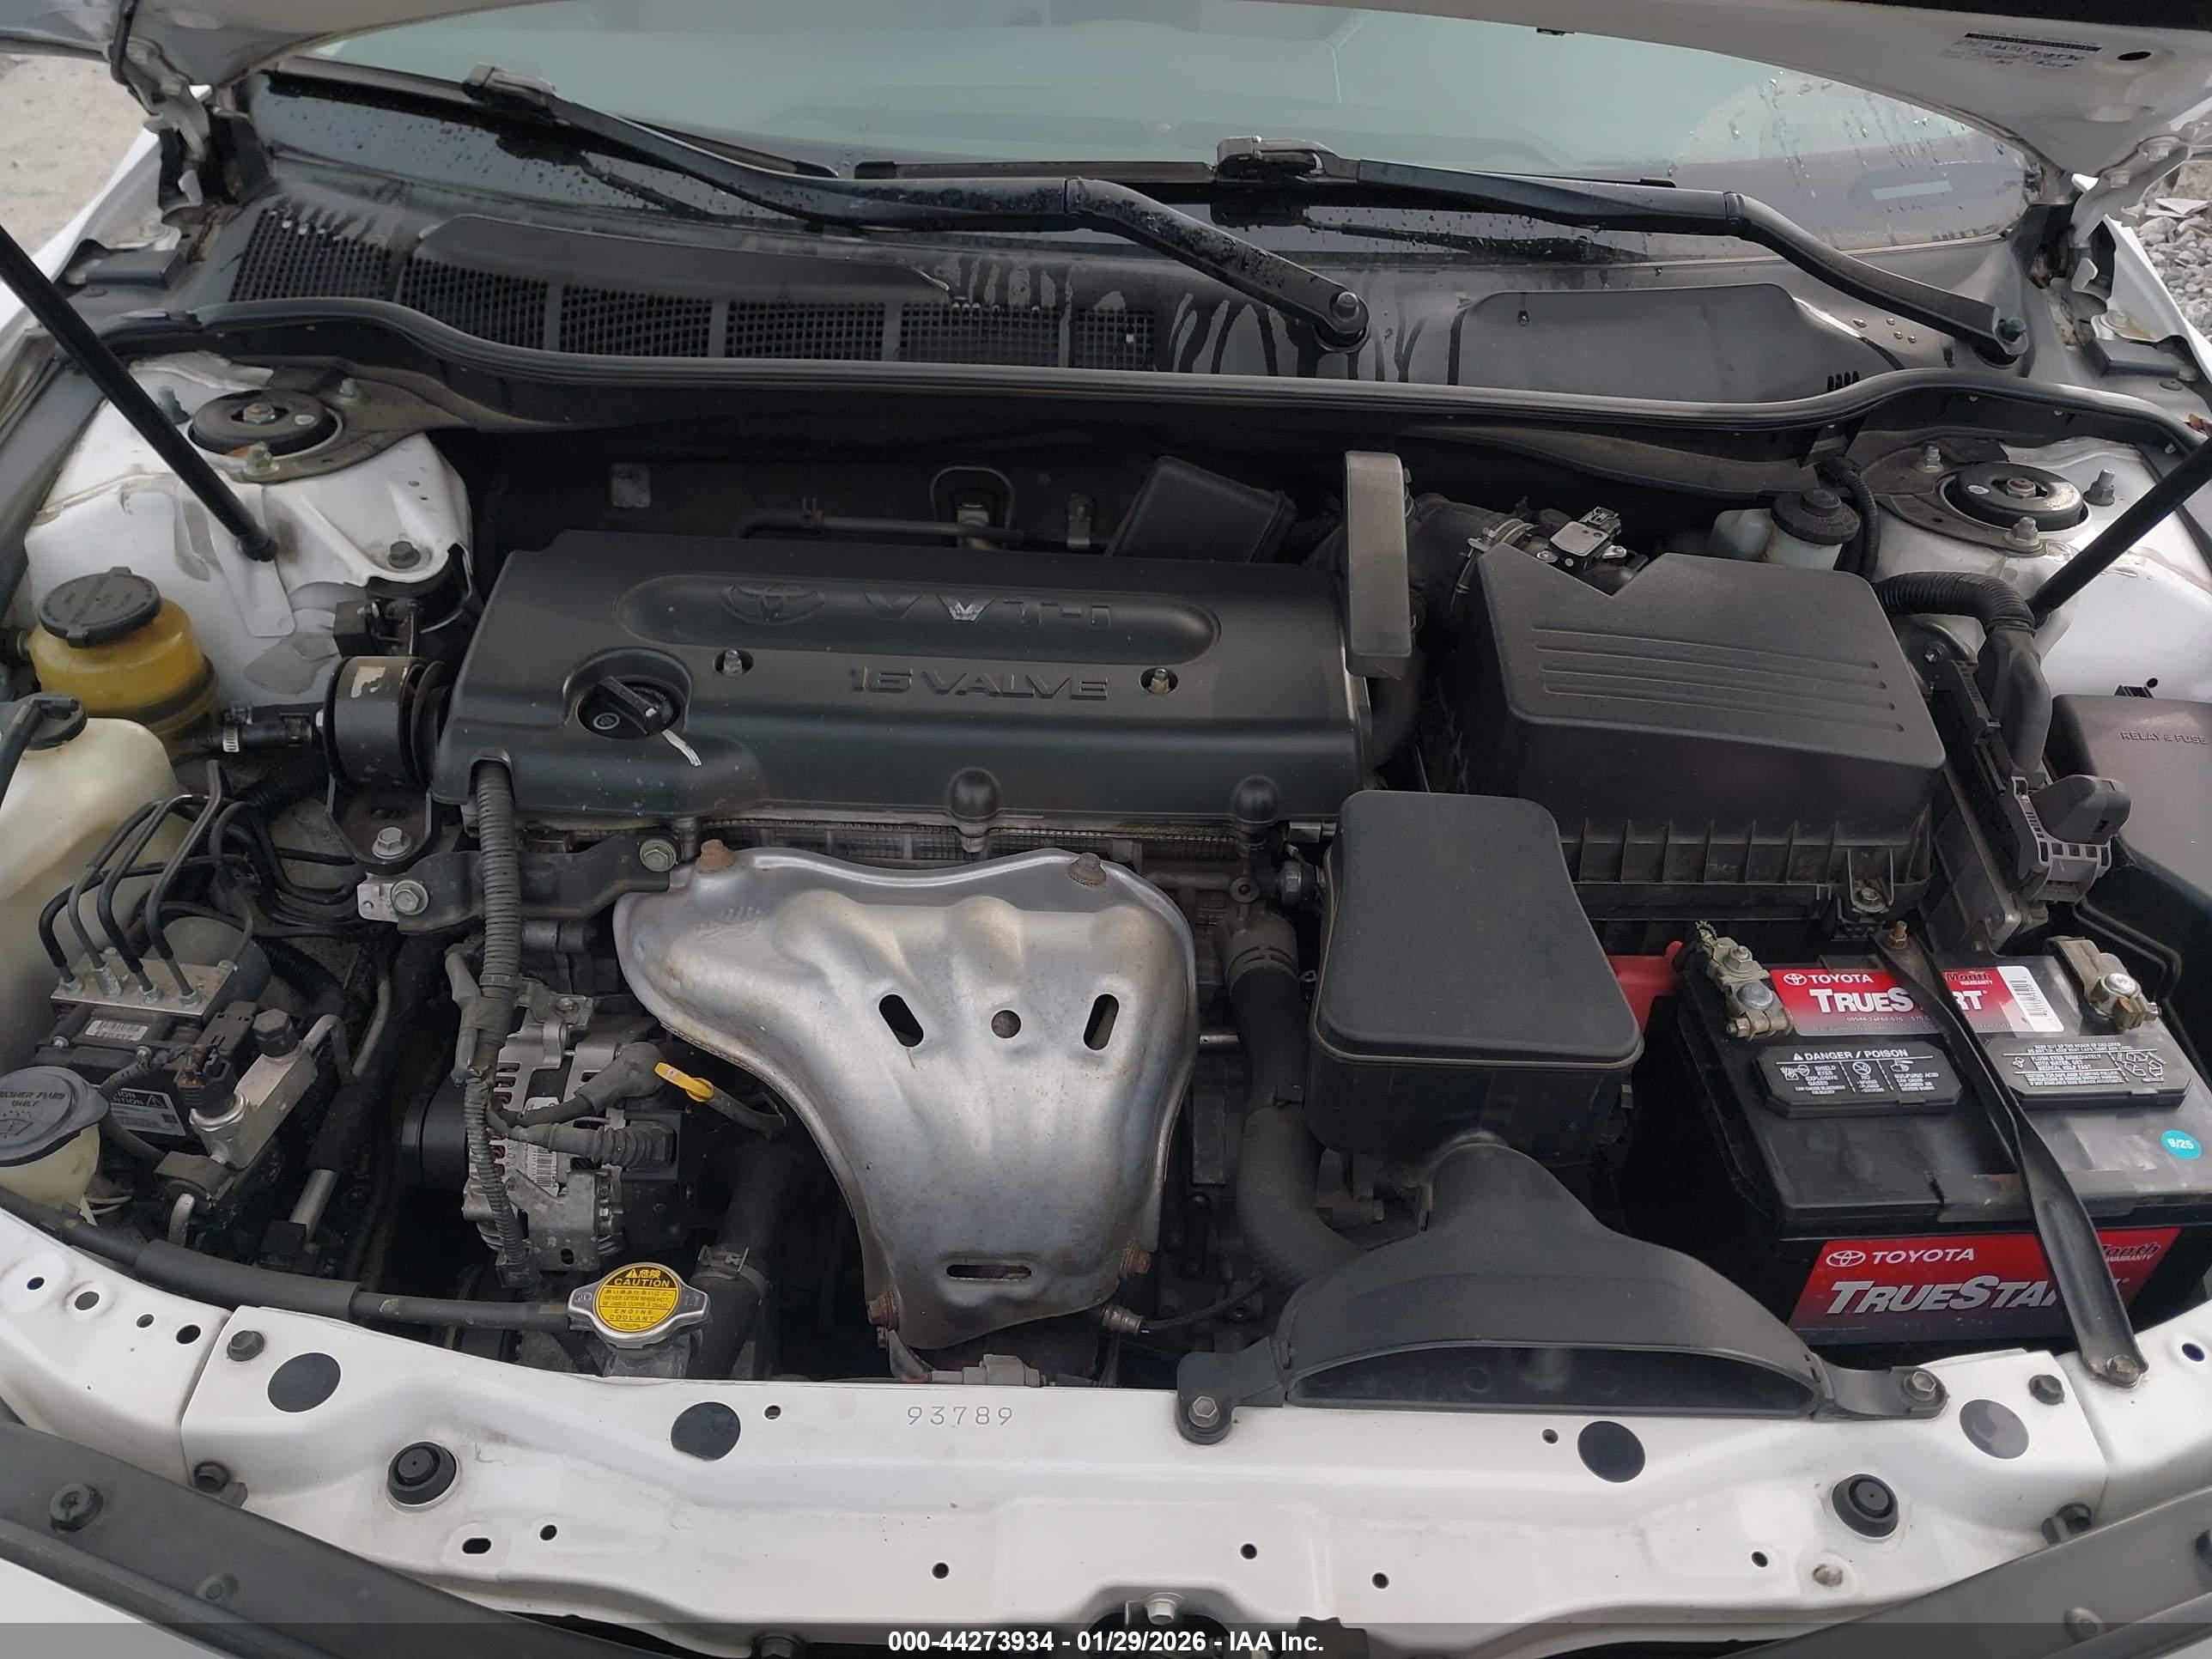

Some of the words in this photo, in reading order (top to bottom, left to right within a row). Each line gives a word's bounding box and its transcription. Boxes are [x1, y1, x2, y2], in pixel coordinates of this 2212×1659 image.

[850, 665, 913, 693] 16
[921, 671, 1109, 701] VALVE
[2119, 730, 2160, 741] RELAY
[2163, 733, 2173, 743] &
[2174, 733, 2209, 745] FUSE
[1808, 973, 1875, 985] TOYOTA
[1804, 1051, 1853, 1060] DANGER
[1863, 1048, 1908, 1058] POISON
[2166, 1138, 2195, 1150] 9/25
[1872, 1248, 1974, 1266] TOYOTA
[614, 1278, 670, 1287] CAUTION
[907, 1406, 1013, 1426] 93789
